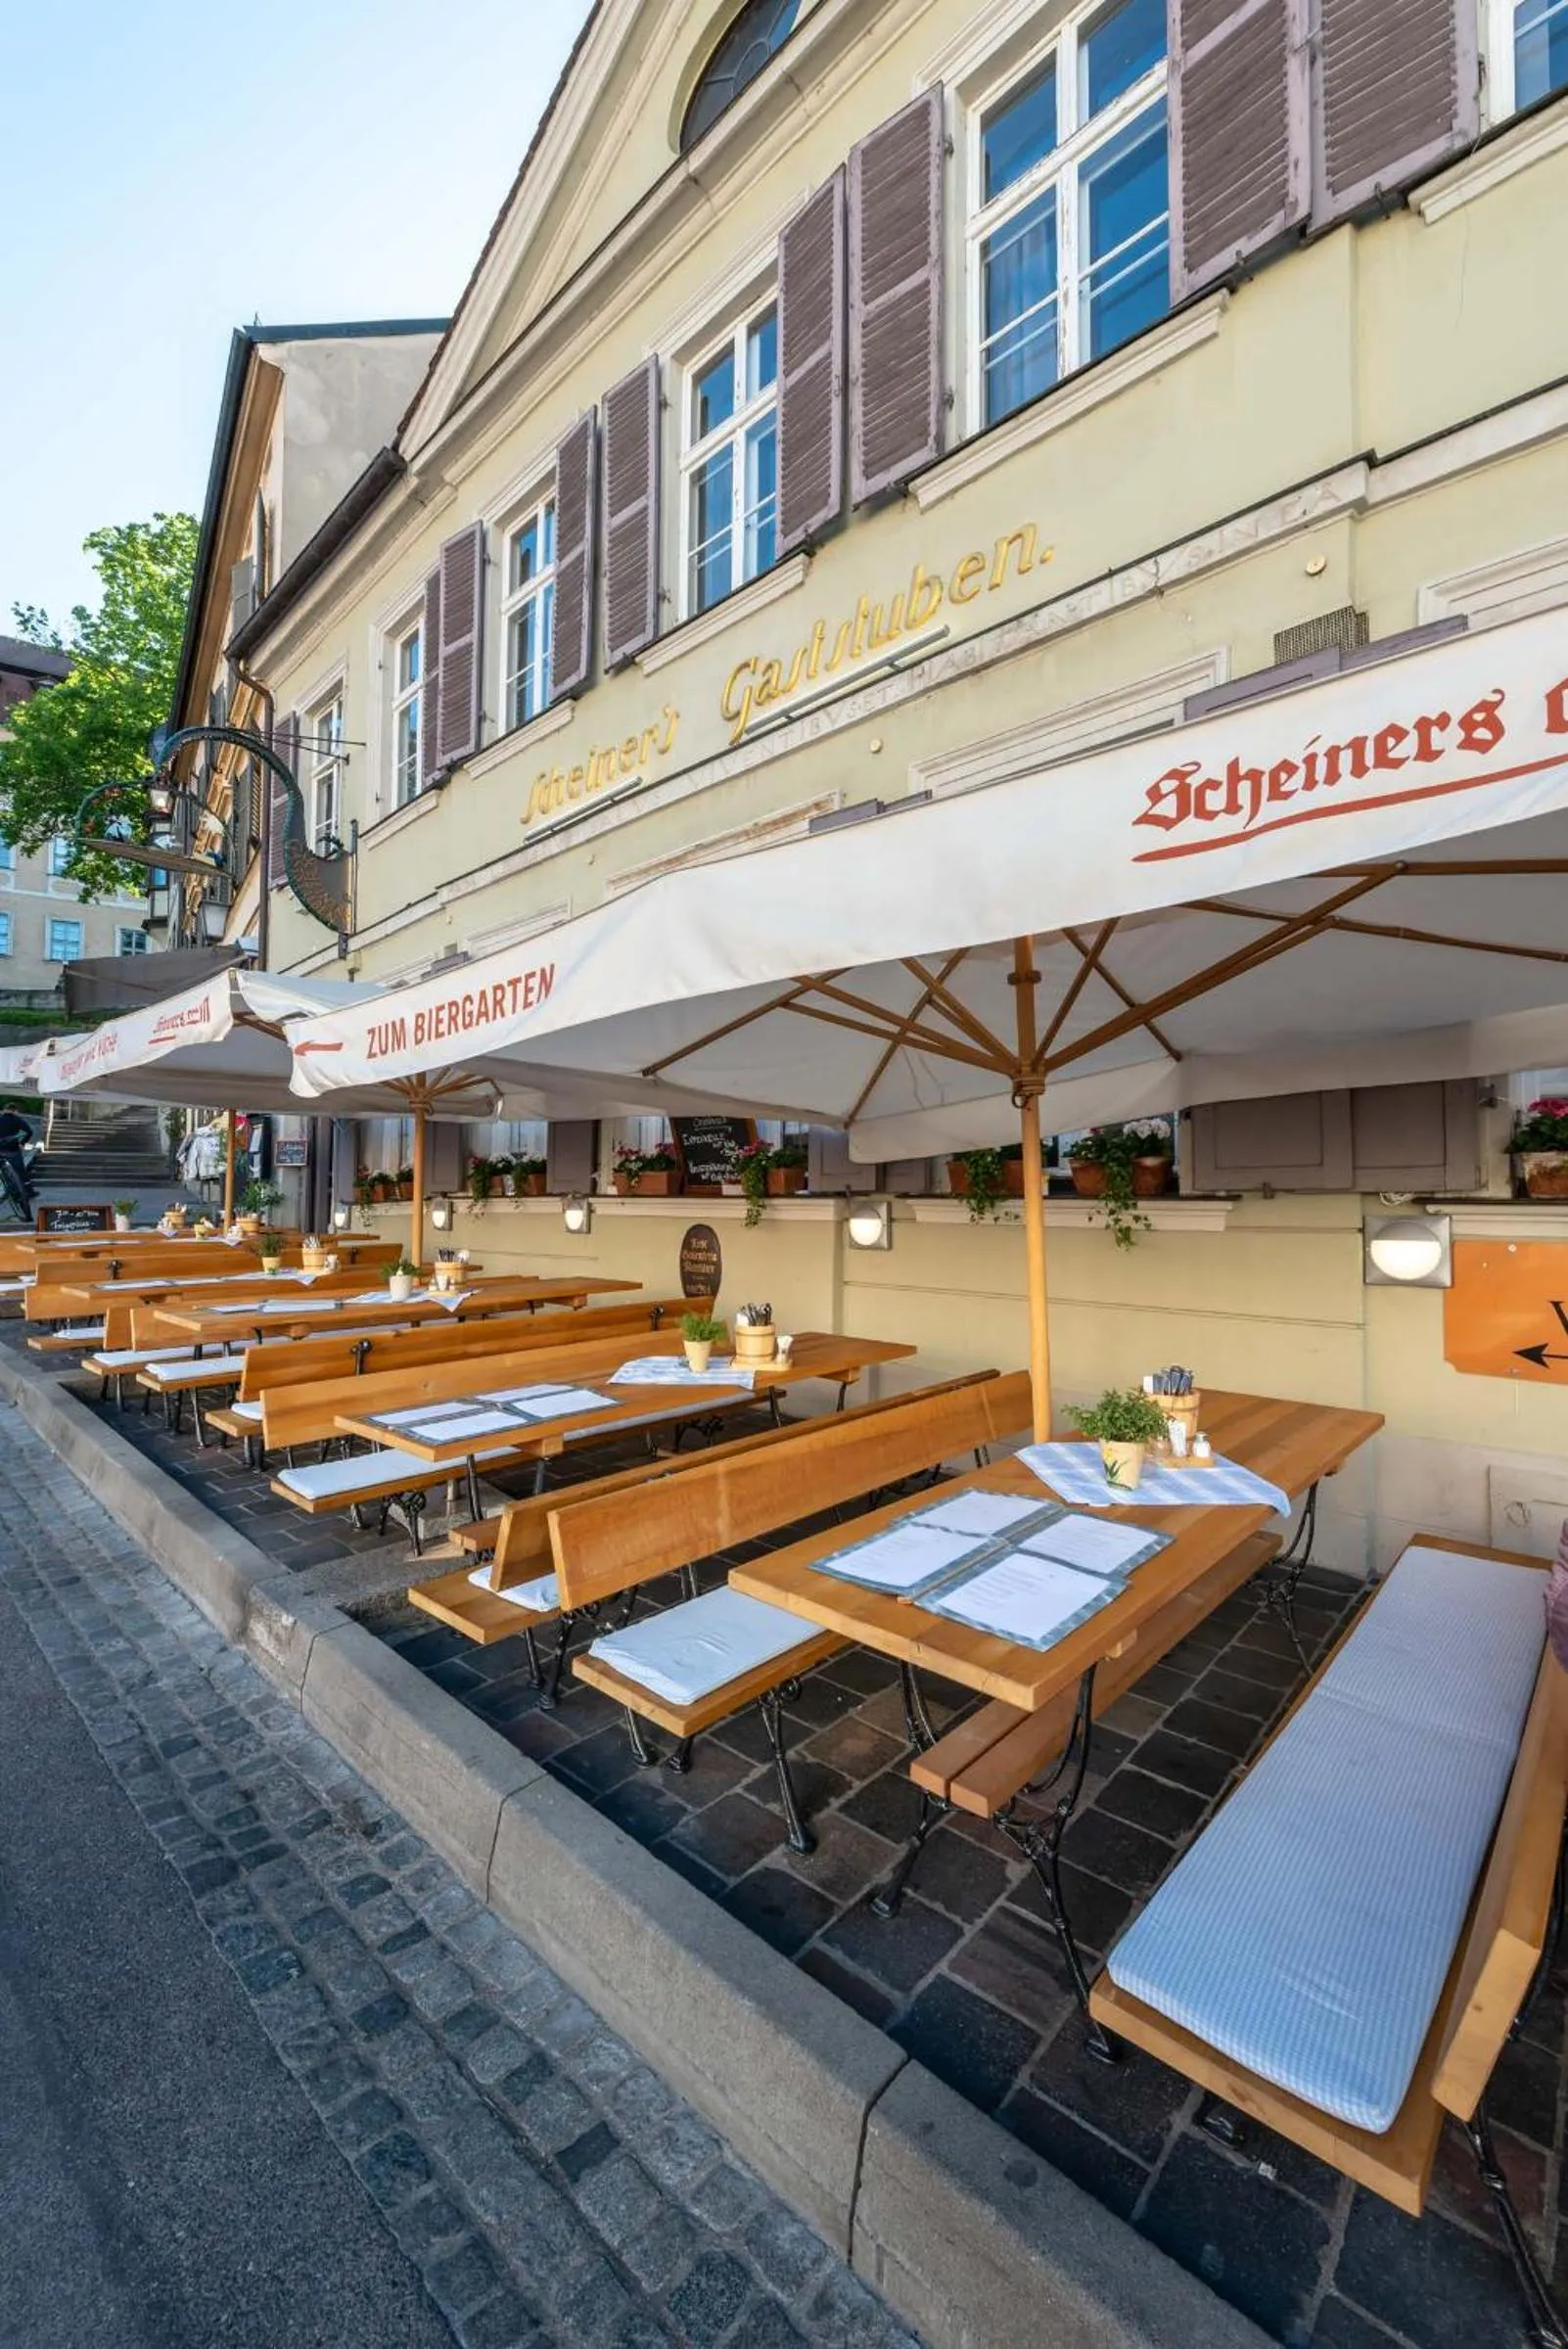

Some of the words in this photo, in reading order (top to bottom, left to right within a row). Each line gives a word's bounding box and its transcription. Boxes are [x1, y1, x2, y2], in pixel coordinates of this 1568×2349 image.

[1131, 688, 1505, 831] Scheiners
[367, 1017, 407, 1059] ZUM
[414, 963, 555, 1046] BIERGARTEN
